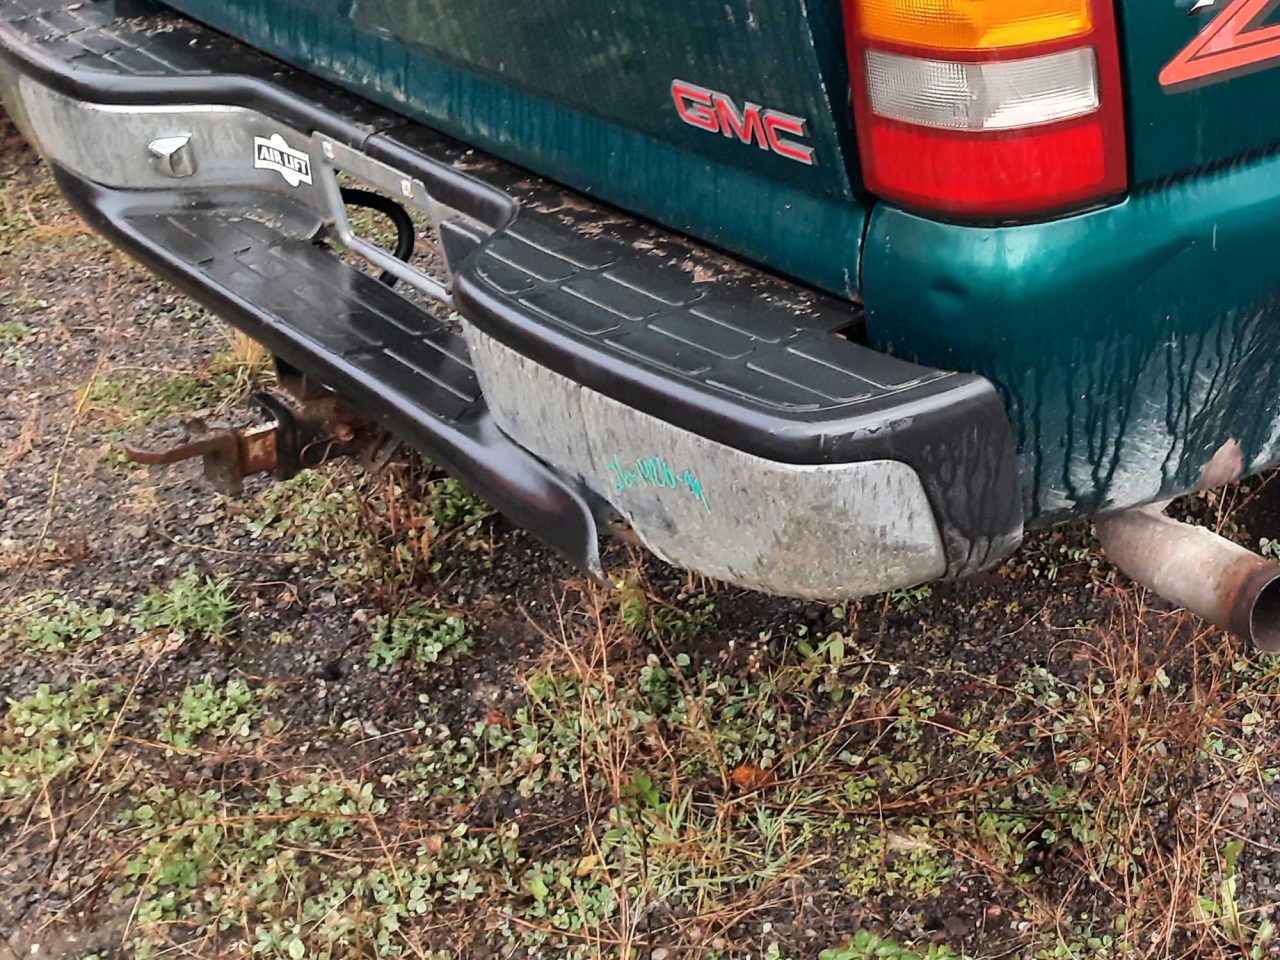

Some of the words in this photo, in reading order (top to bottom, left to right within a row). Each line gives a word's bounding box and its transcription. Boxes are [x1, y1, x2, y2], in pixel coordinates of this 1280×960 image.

[670, 78, 820, 166] GMC
[259, 145, 284, 166] AIR
[283, 152, 308, 175] LIFT
